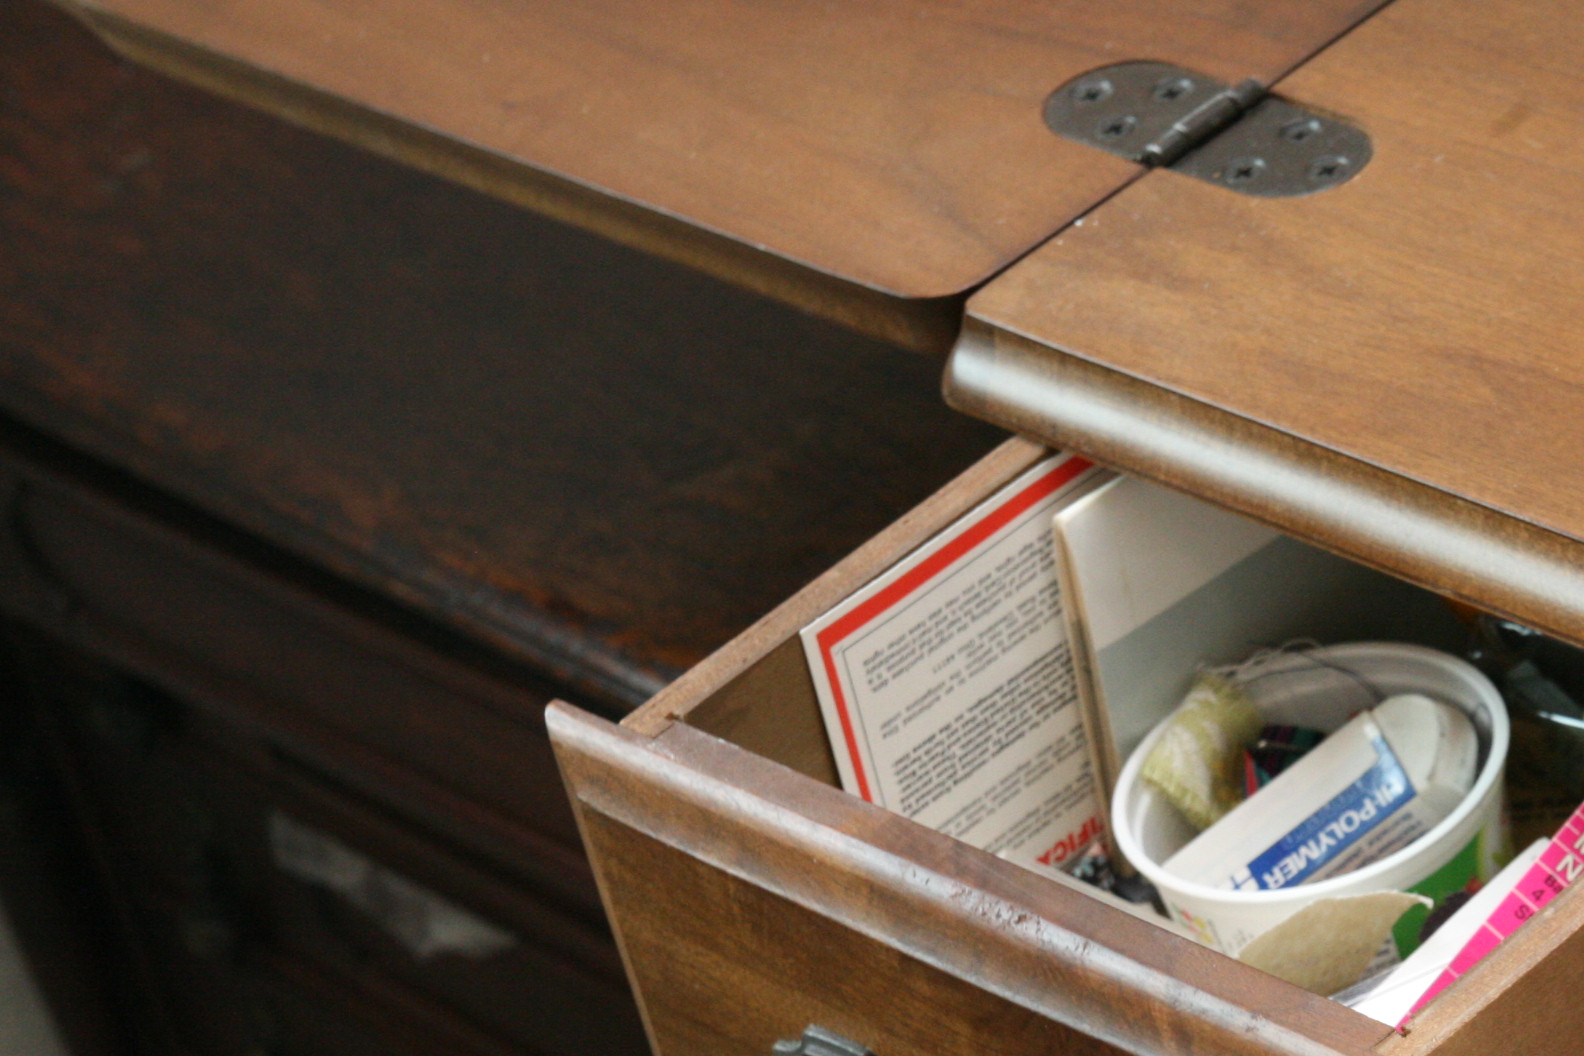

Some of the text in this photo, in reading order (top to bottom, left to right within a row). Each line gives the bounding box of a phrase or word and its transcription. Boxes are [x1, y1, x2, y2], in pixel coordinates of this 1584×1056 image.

[1556, 853, 1582, 882] N
[1529, 886, 1546, 902] 4
[1542, 874, 1564, 895] Ba
[1513, 904, 1532, 923] S
